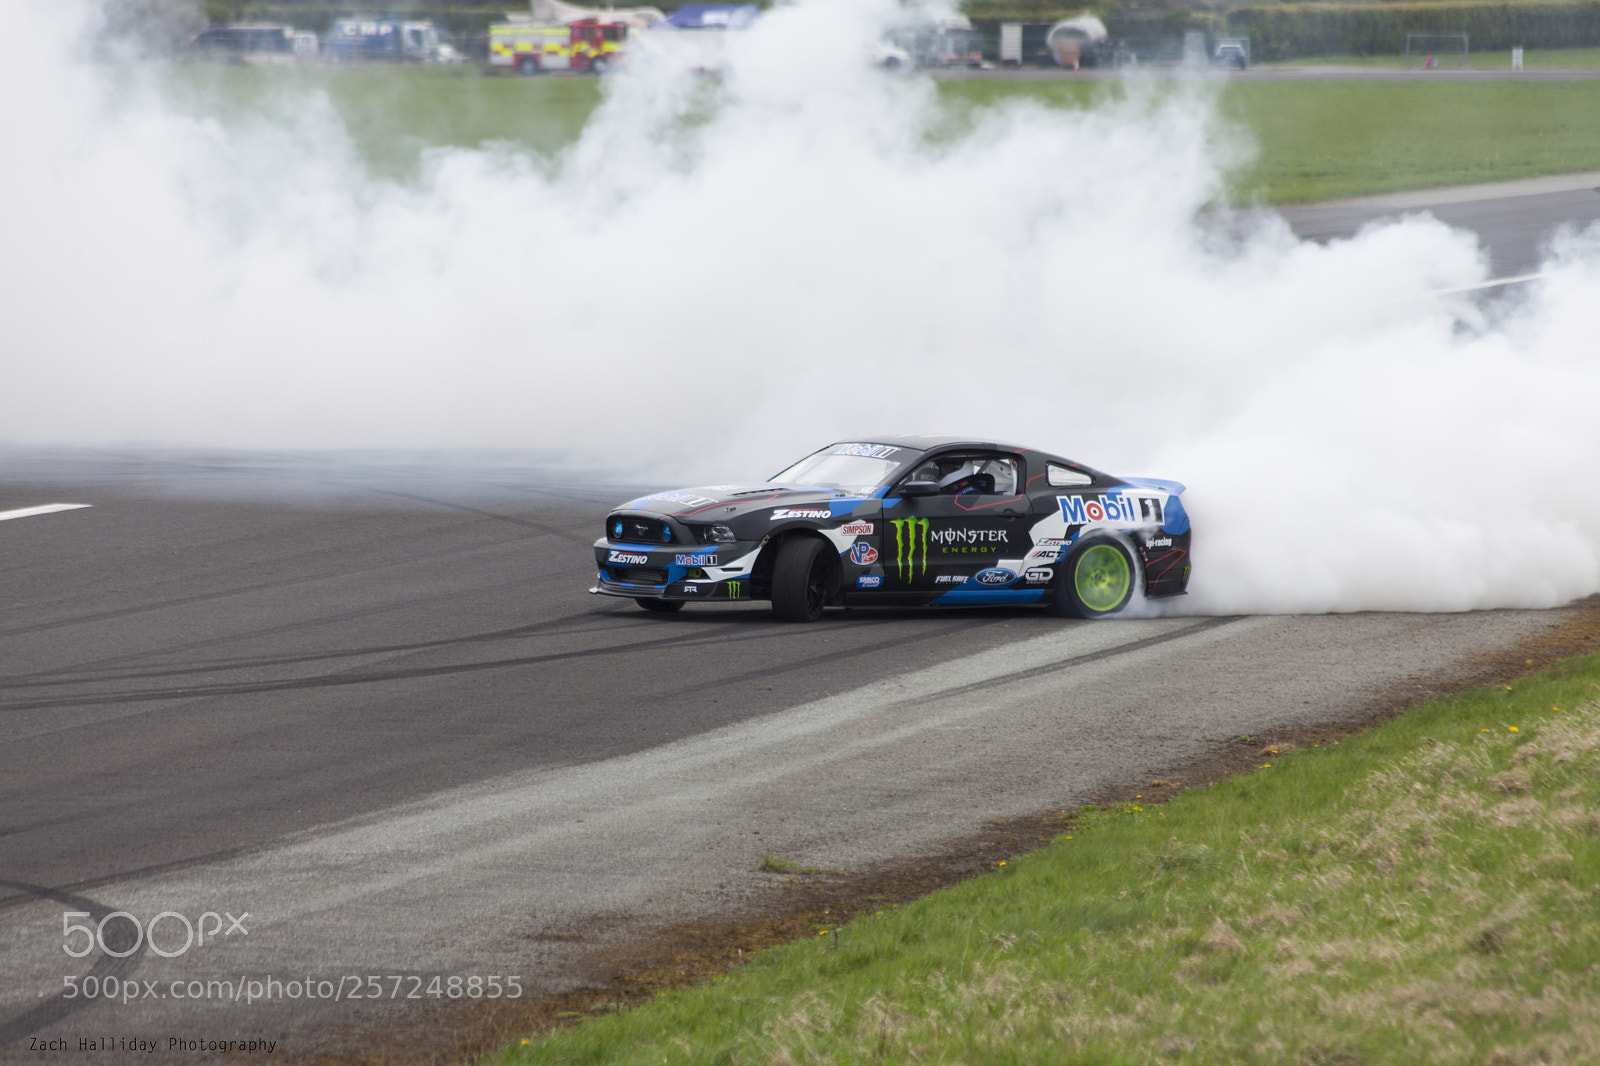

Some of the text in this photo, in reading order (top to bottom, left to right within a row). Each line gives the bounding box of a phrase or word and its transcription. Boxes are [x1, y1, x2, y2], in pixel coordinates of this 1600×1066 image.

[770, 508, 832, 520] ZESTINO
[1058, 496, 1135, 524] Mobil
[843, 525, 872, 535] SIMPSON
[930, 528, 1009, 544] MONSTER
[608, 551, 648, 564] ZESTINO
[851, 542, 870, 564] VP
[676, 555, 705, 565] Mobil
[935, 576, 952, 584] FUEL
[982, 571, 1008, 583] Ford
